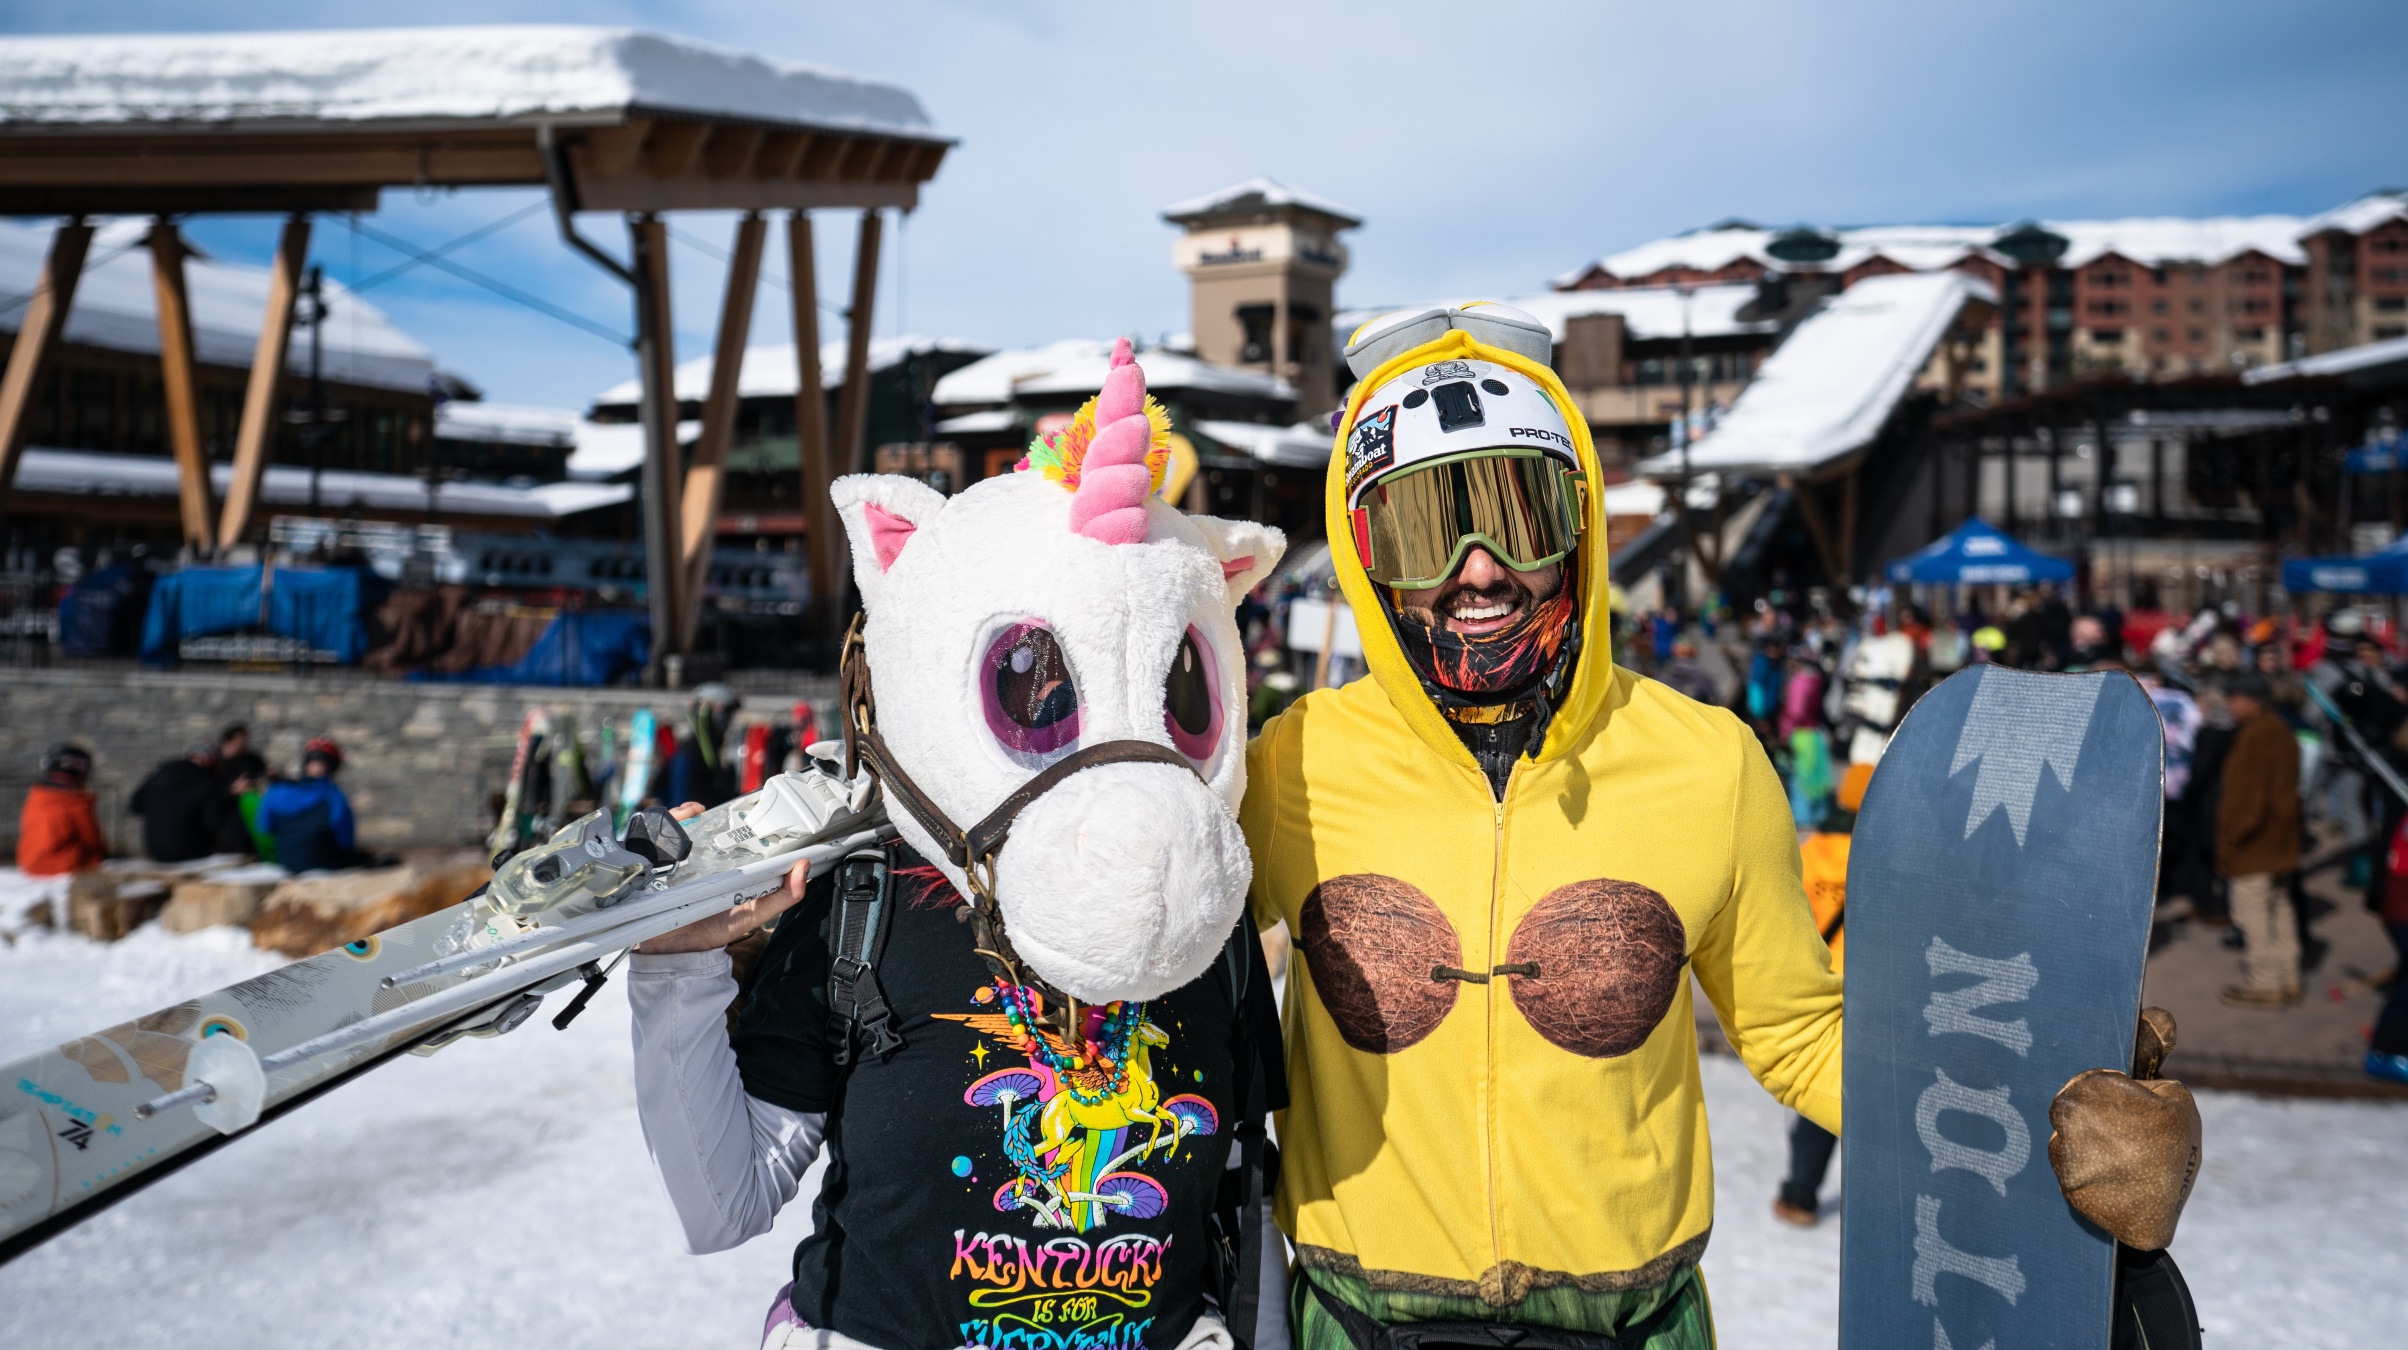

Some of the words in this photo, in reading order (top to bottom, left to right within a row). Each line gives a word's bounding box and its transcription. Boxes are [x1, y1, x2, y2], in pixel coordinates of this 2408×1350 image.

[57, 1118, 95, 1151] 74
[1911, 935, 2040, 1350] TON
[2176, 1145, 2198, 1214] KINCO
[951, 1229, 1173, 1289] KENTUCKY
[1032, 1299, 1054, 1323] IS
[1059, 1296, 1098, 1323] FOR
